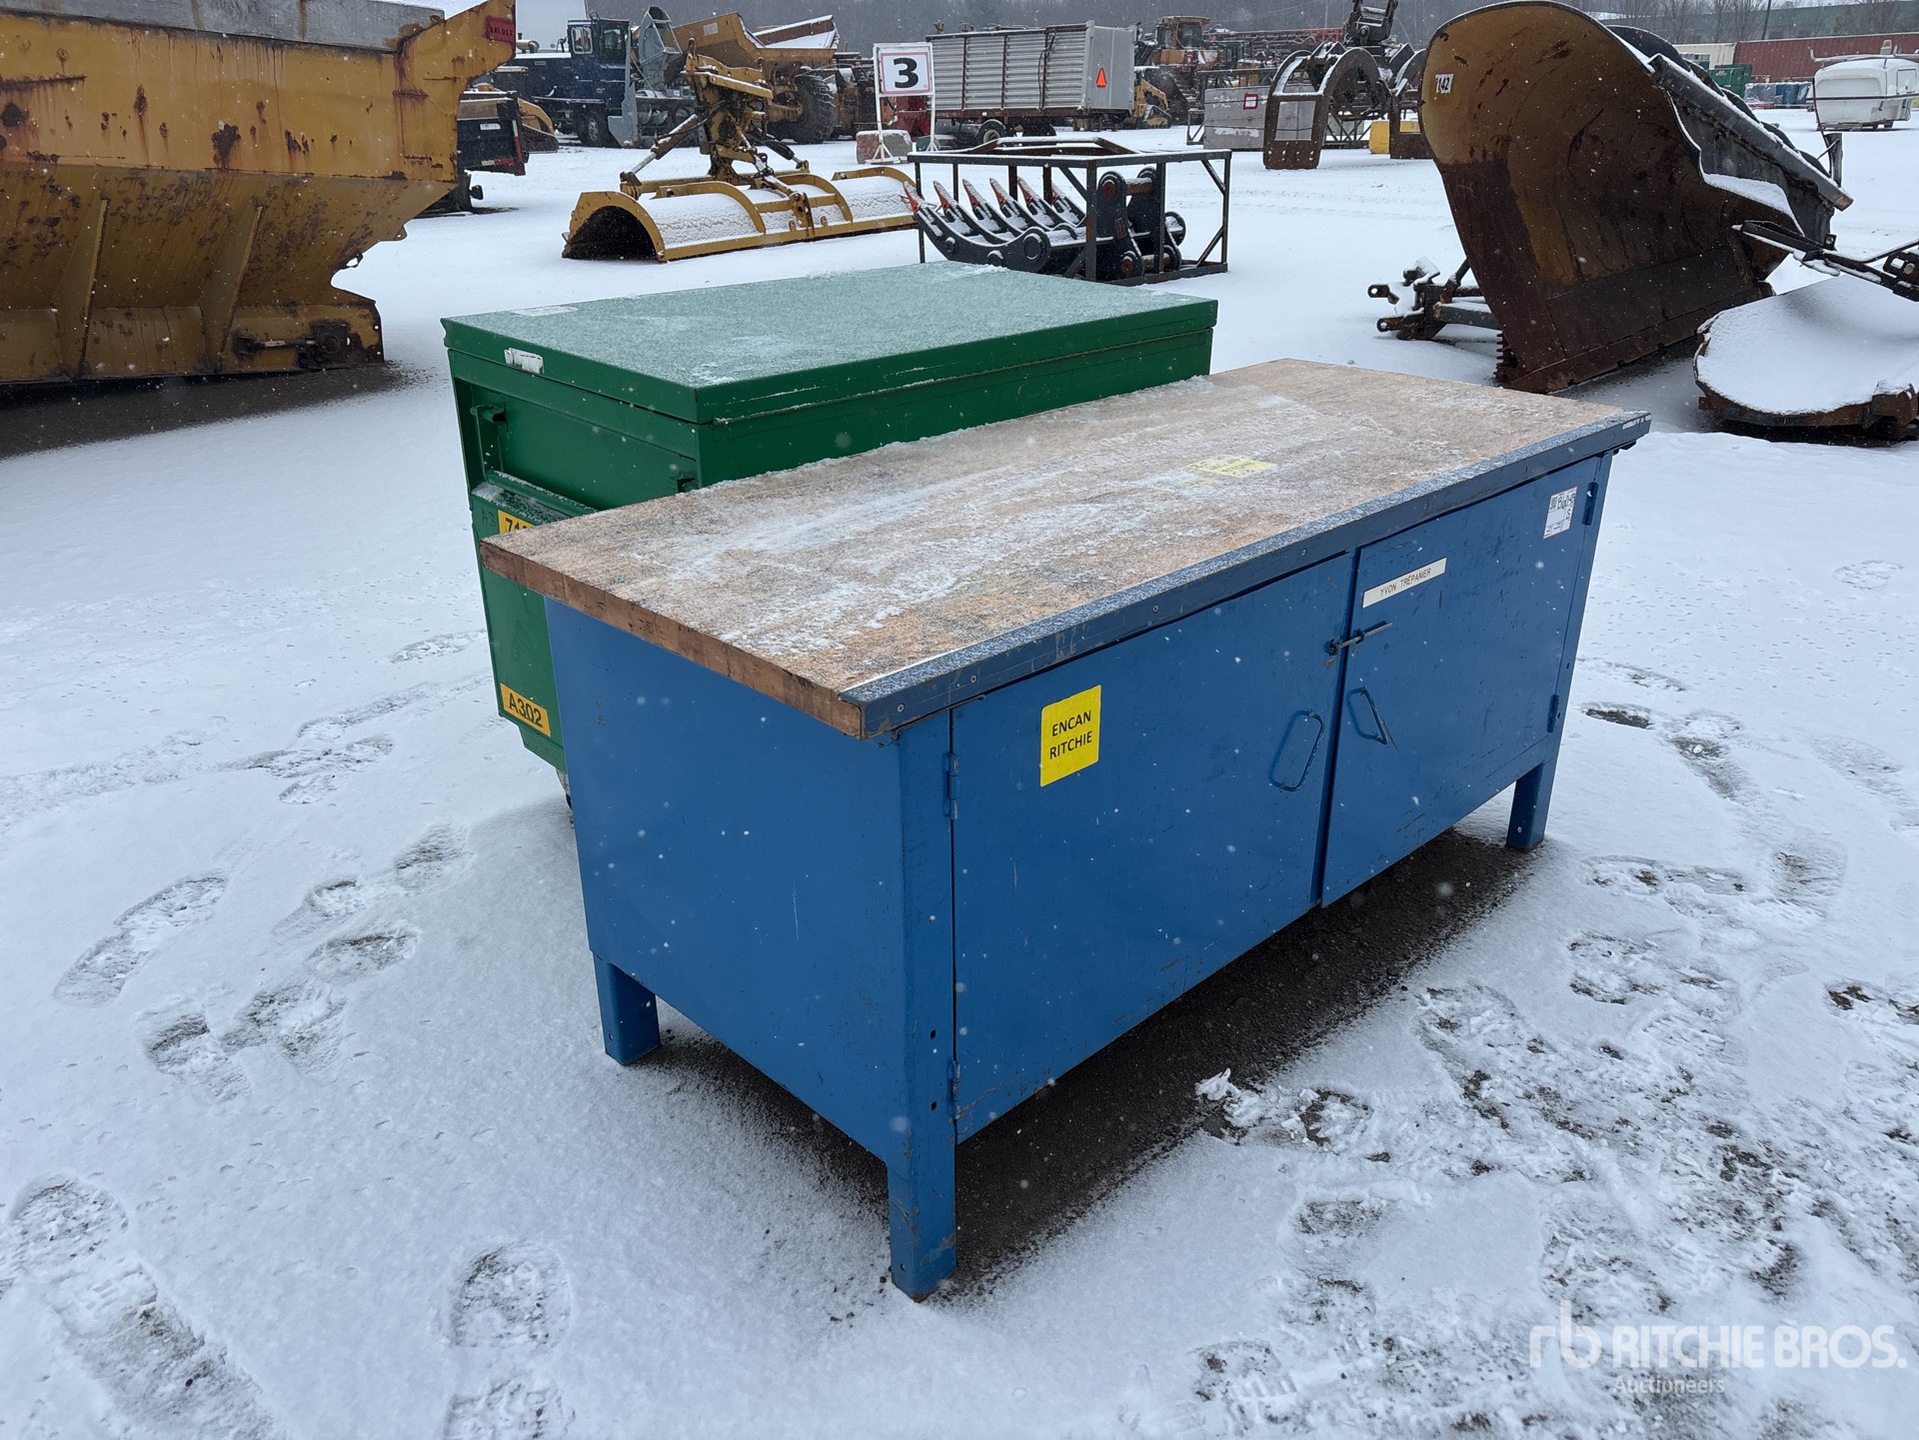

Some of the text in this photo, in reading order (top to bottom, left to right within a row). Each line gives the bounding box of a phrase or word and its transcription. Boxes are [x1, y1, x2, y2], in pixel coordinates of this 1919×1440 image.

[893, 57, 919, 88] 3
[1380, 567, 1432, 597] YVON TRÉPANIER
[509, 692, 544, 728] A302
[1052, 710, 1092, 738] ENCAN
[1049, 730, 1093, 760] RITCHIE
